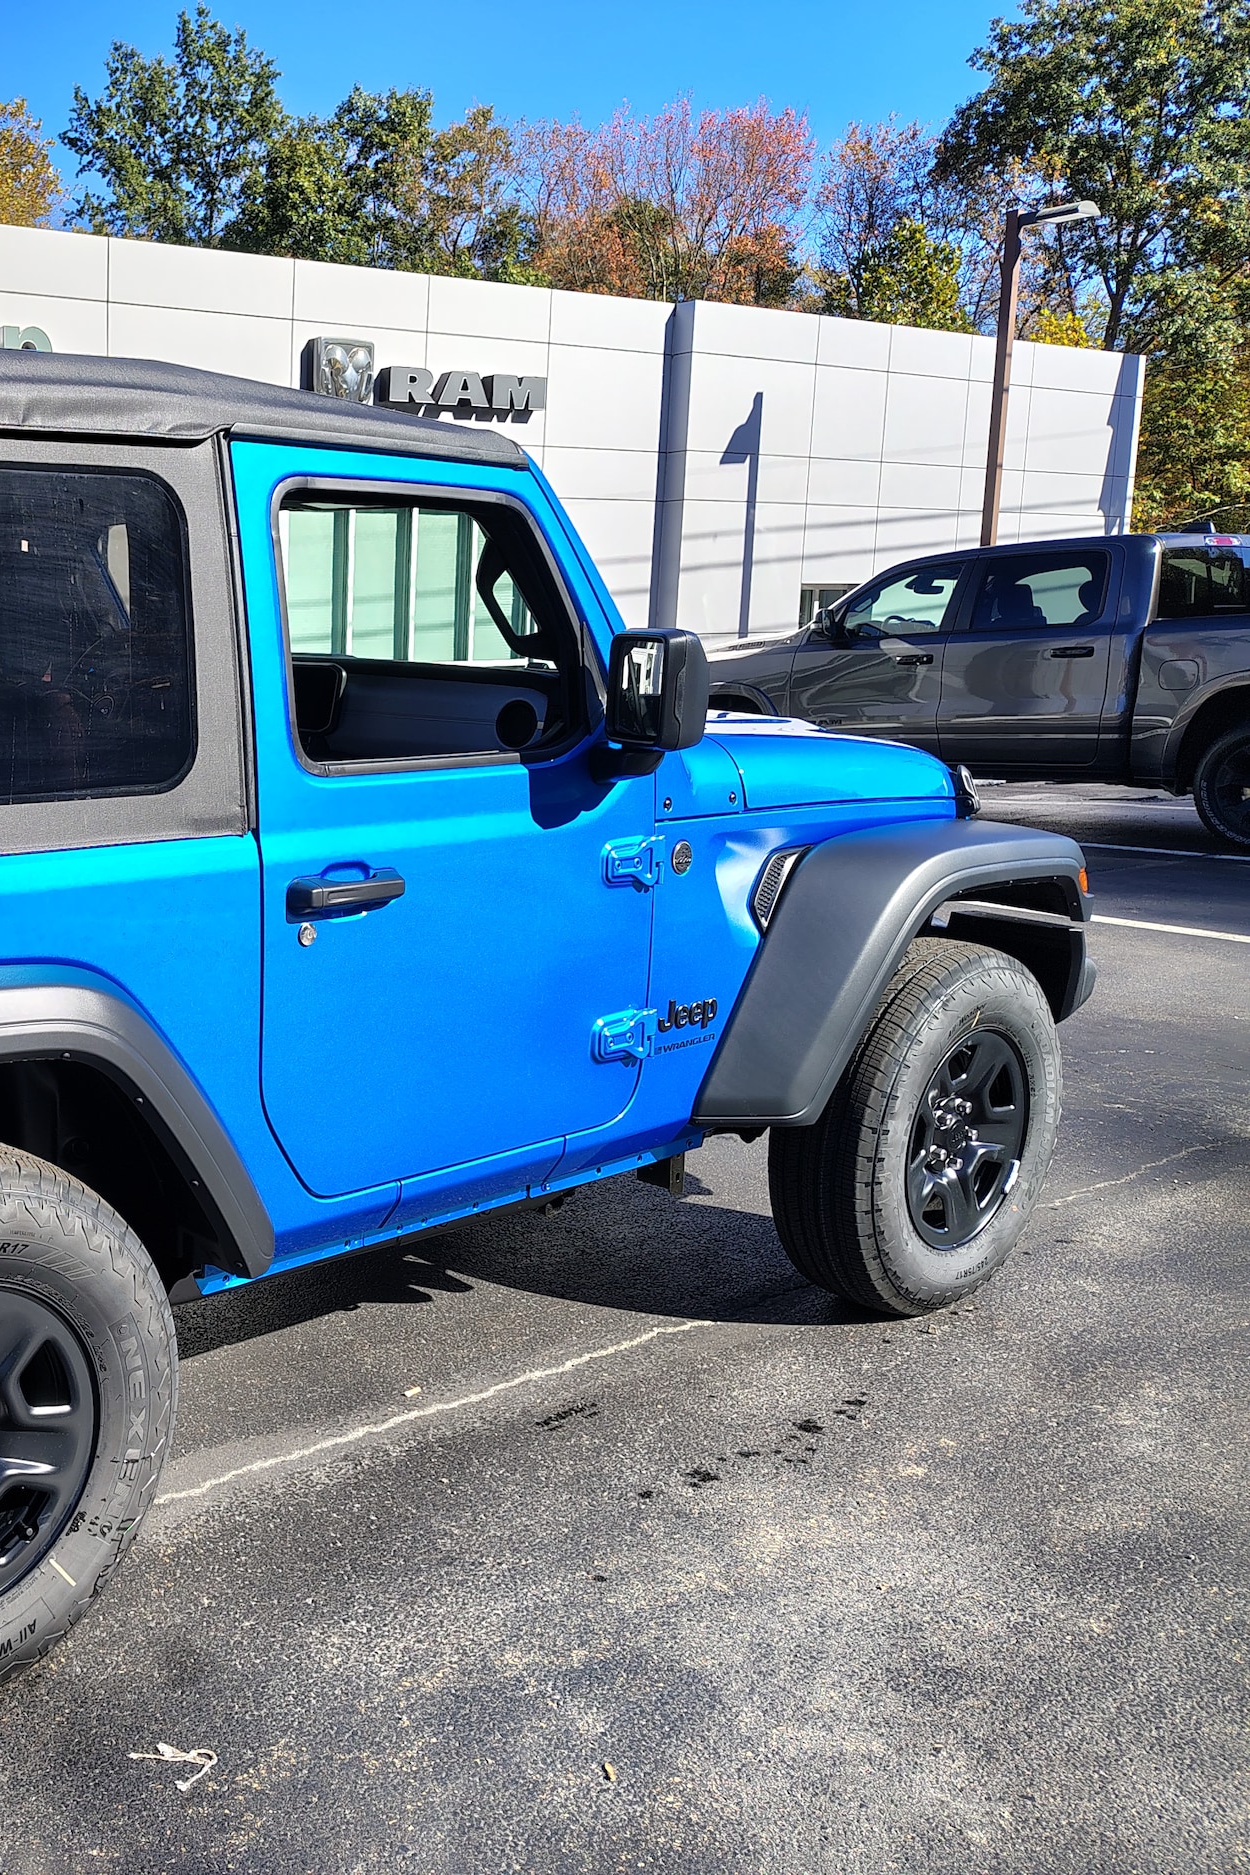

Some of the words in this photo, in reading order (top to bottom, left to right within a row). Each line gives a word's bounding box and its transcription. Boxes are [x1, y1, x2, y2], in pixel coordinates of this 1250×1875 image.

[378, 365, 547, 411] RAM
[658, 997, 717, 1033] Jeep
[662, 1033, 716, 1054] WRANGLER
[104, 1335, 146, 1520] NEXEN
